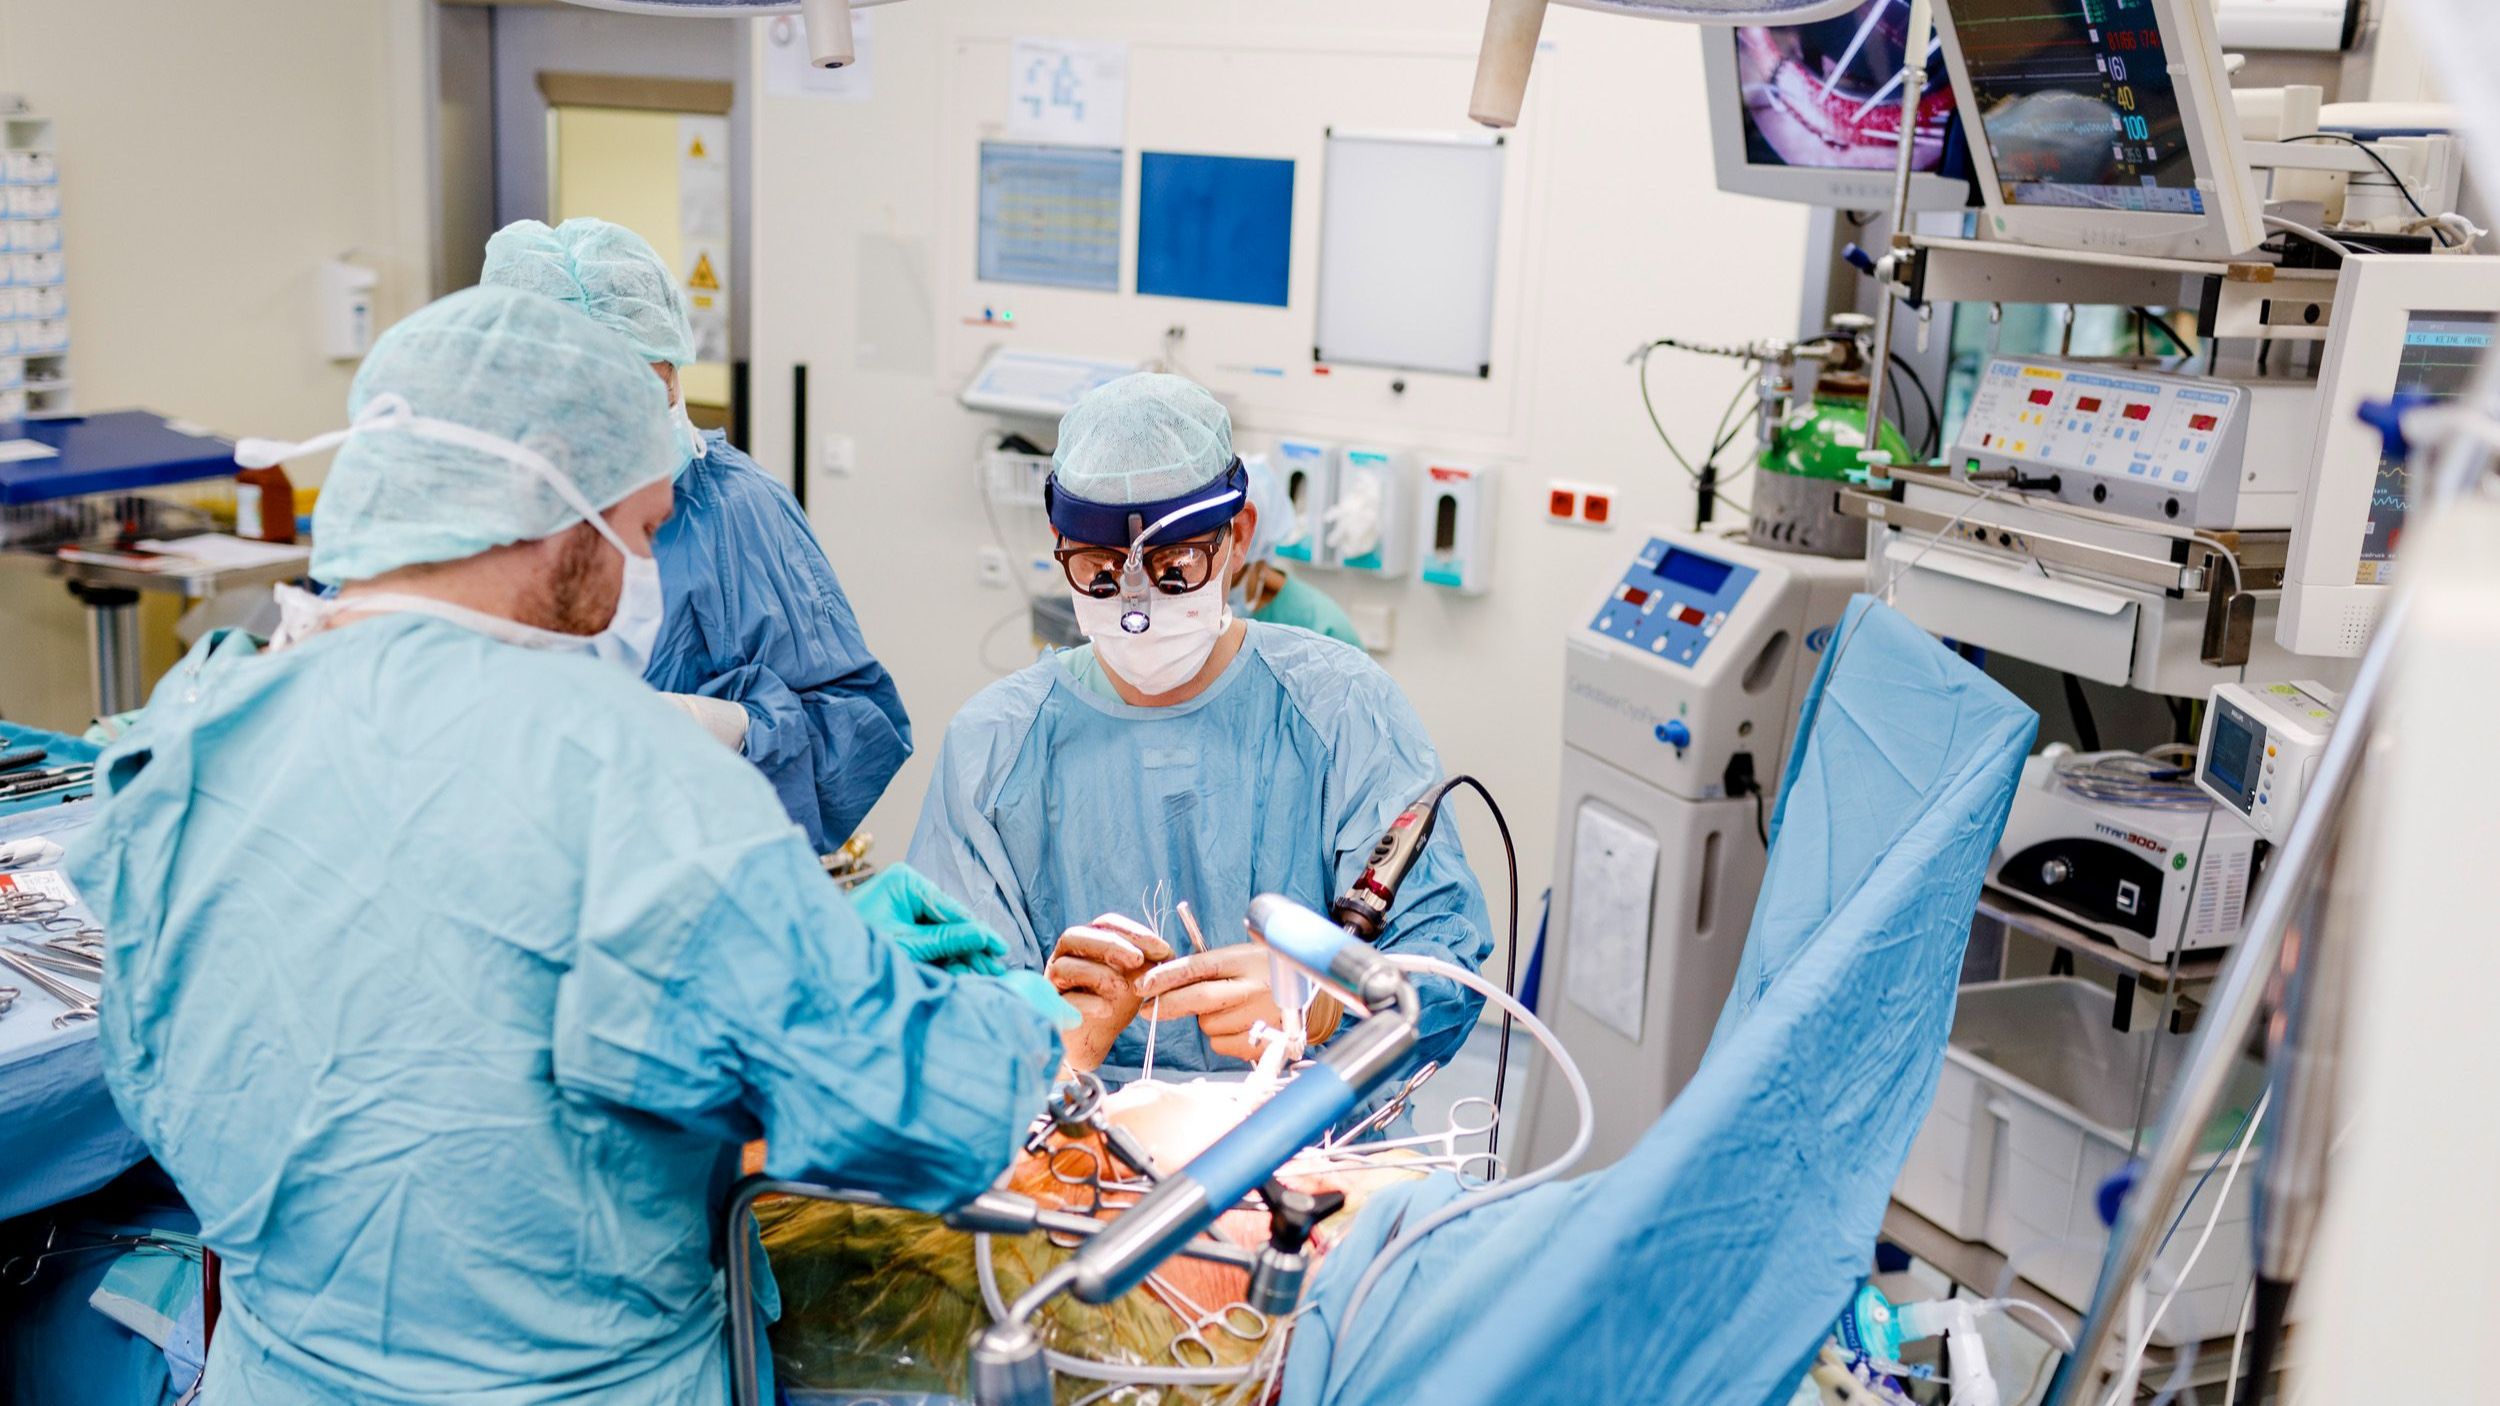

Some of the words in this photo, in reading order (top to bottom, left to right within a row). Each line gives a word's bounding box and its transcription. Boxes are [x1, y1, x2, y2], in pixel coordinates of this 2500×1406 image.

[2107, 55, 2127, 81] (6)
[2117, 85, 2135, 111] 40
[2123, 115, 2148, 140] 100
